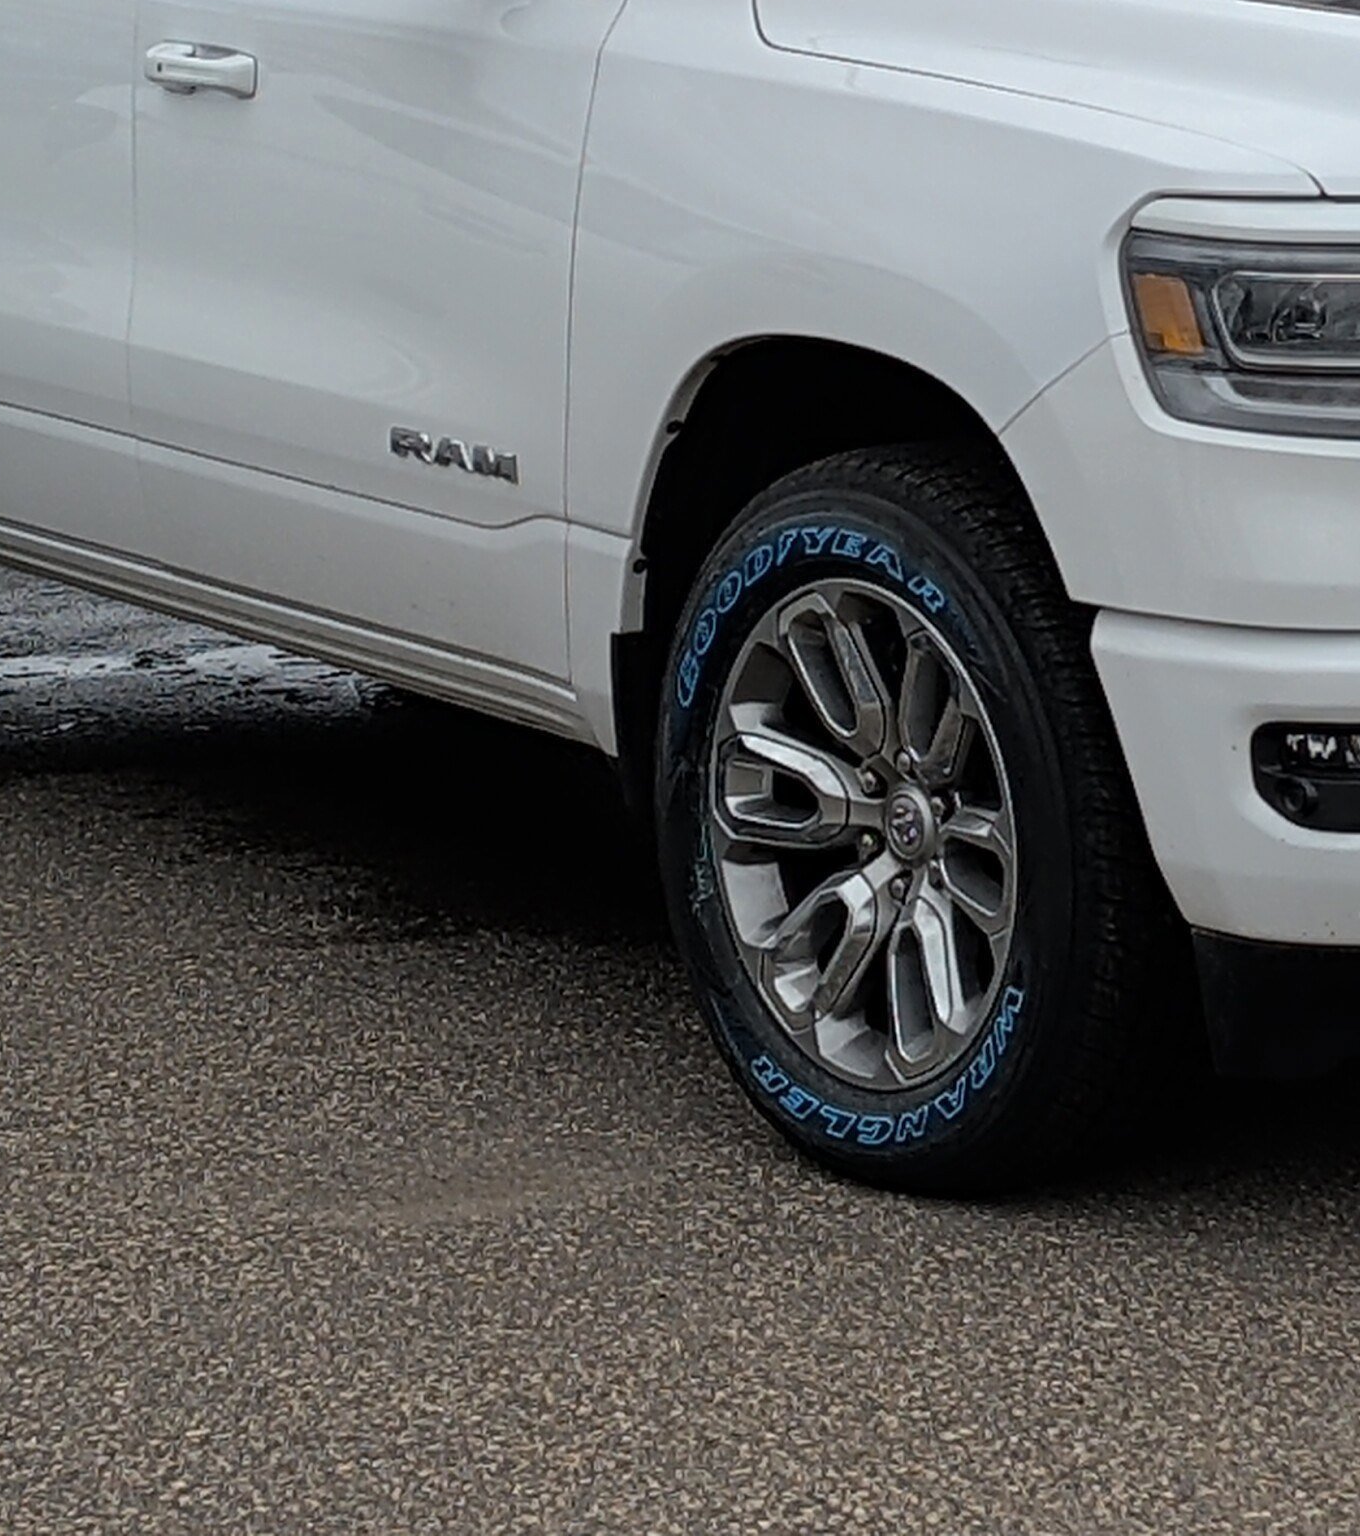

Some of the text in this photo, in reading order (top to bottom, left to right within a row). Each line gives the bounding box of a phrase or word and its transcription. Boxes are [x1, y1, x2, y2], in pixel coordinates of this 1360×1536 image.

[389, 425, 520, 486] RAM
[675, 525, 948, 709] GOODYEAR
[749, 985, 1026, 1146] WRANGLER
